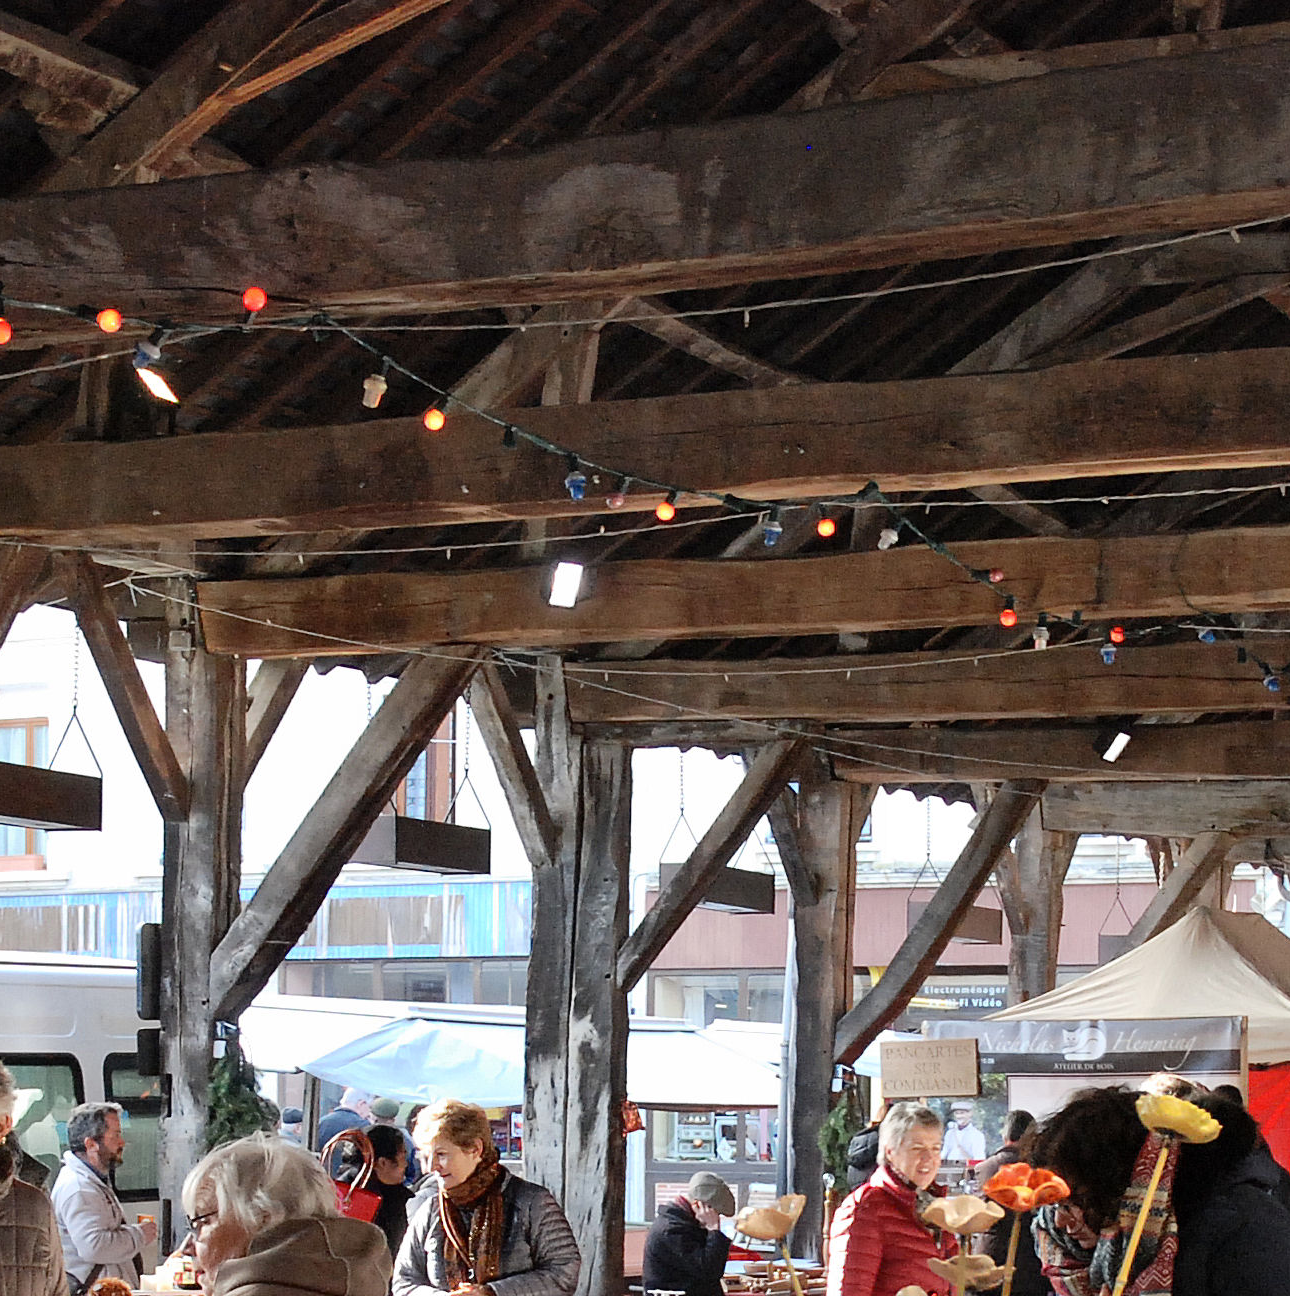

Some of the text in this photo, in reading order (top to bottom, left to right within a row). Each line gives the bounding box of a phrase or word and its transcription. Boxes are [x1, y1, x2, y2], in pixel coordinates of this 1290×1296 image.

[924, 986, 1006, 996] Electroménager
[971, 997, 1003, 1008] Vidéo
[885, 1045, 972, 1060] PANCARTES
[979, 1022, 1199, 1071] Nichlas Hemming
[914, 1062, 942, 1075] SUR
[1053, 1062, 1083, 1070] ATELIER
[1096, 1062, 1114, 1070] BOIS
[884, 1078, 972, 1092] COMMANDE
